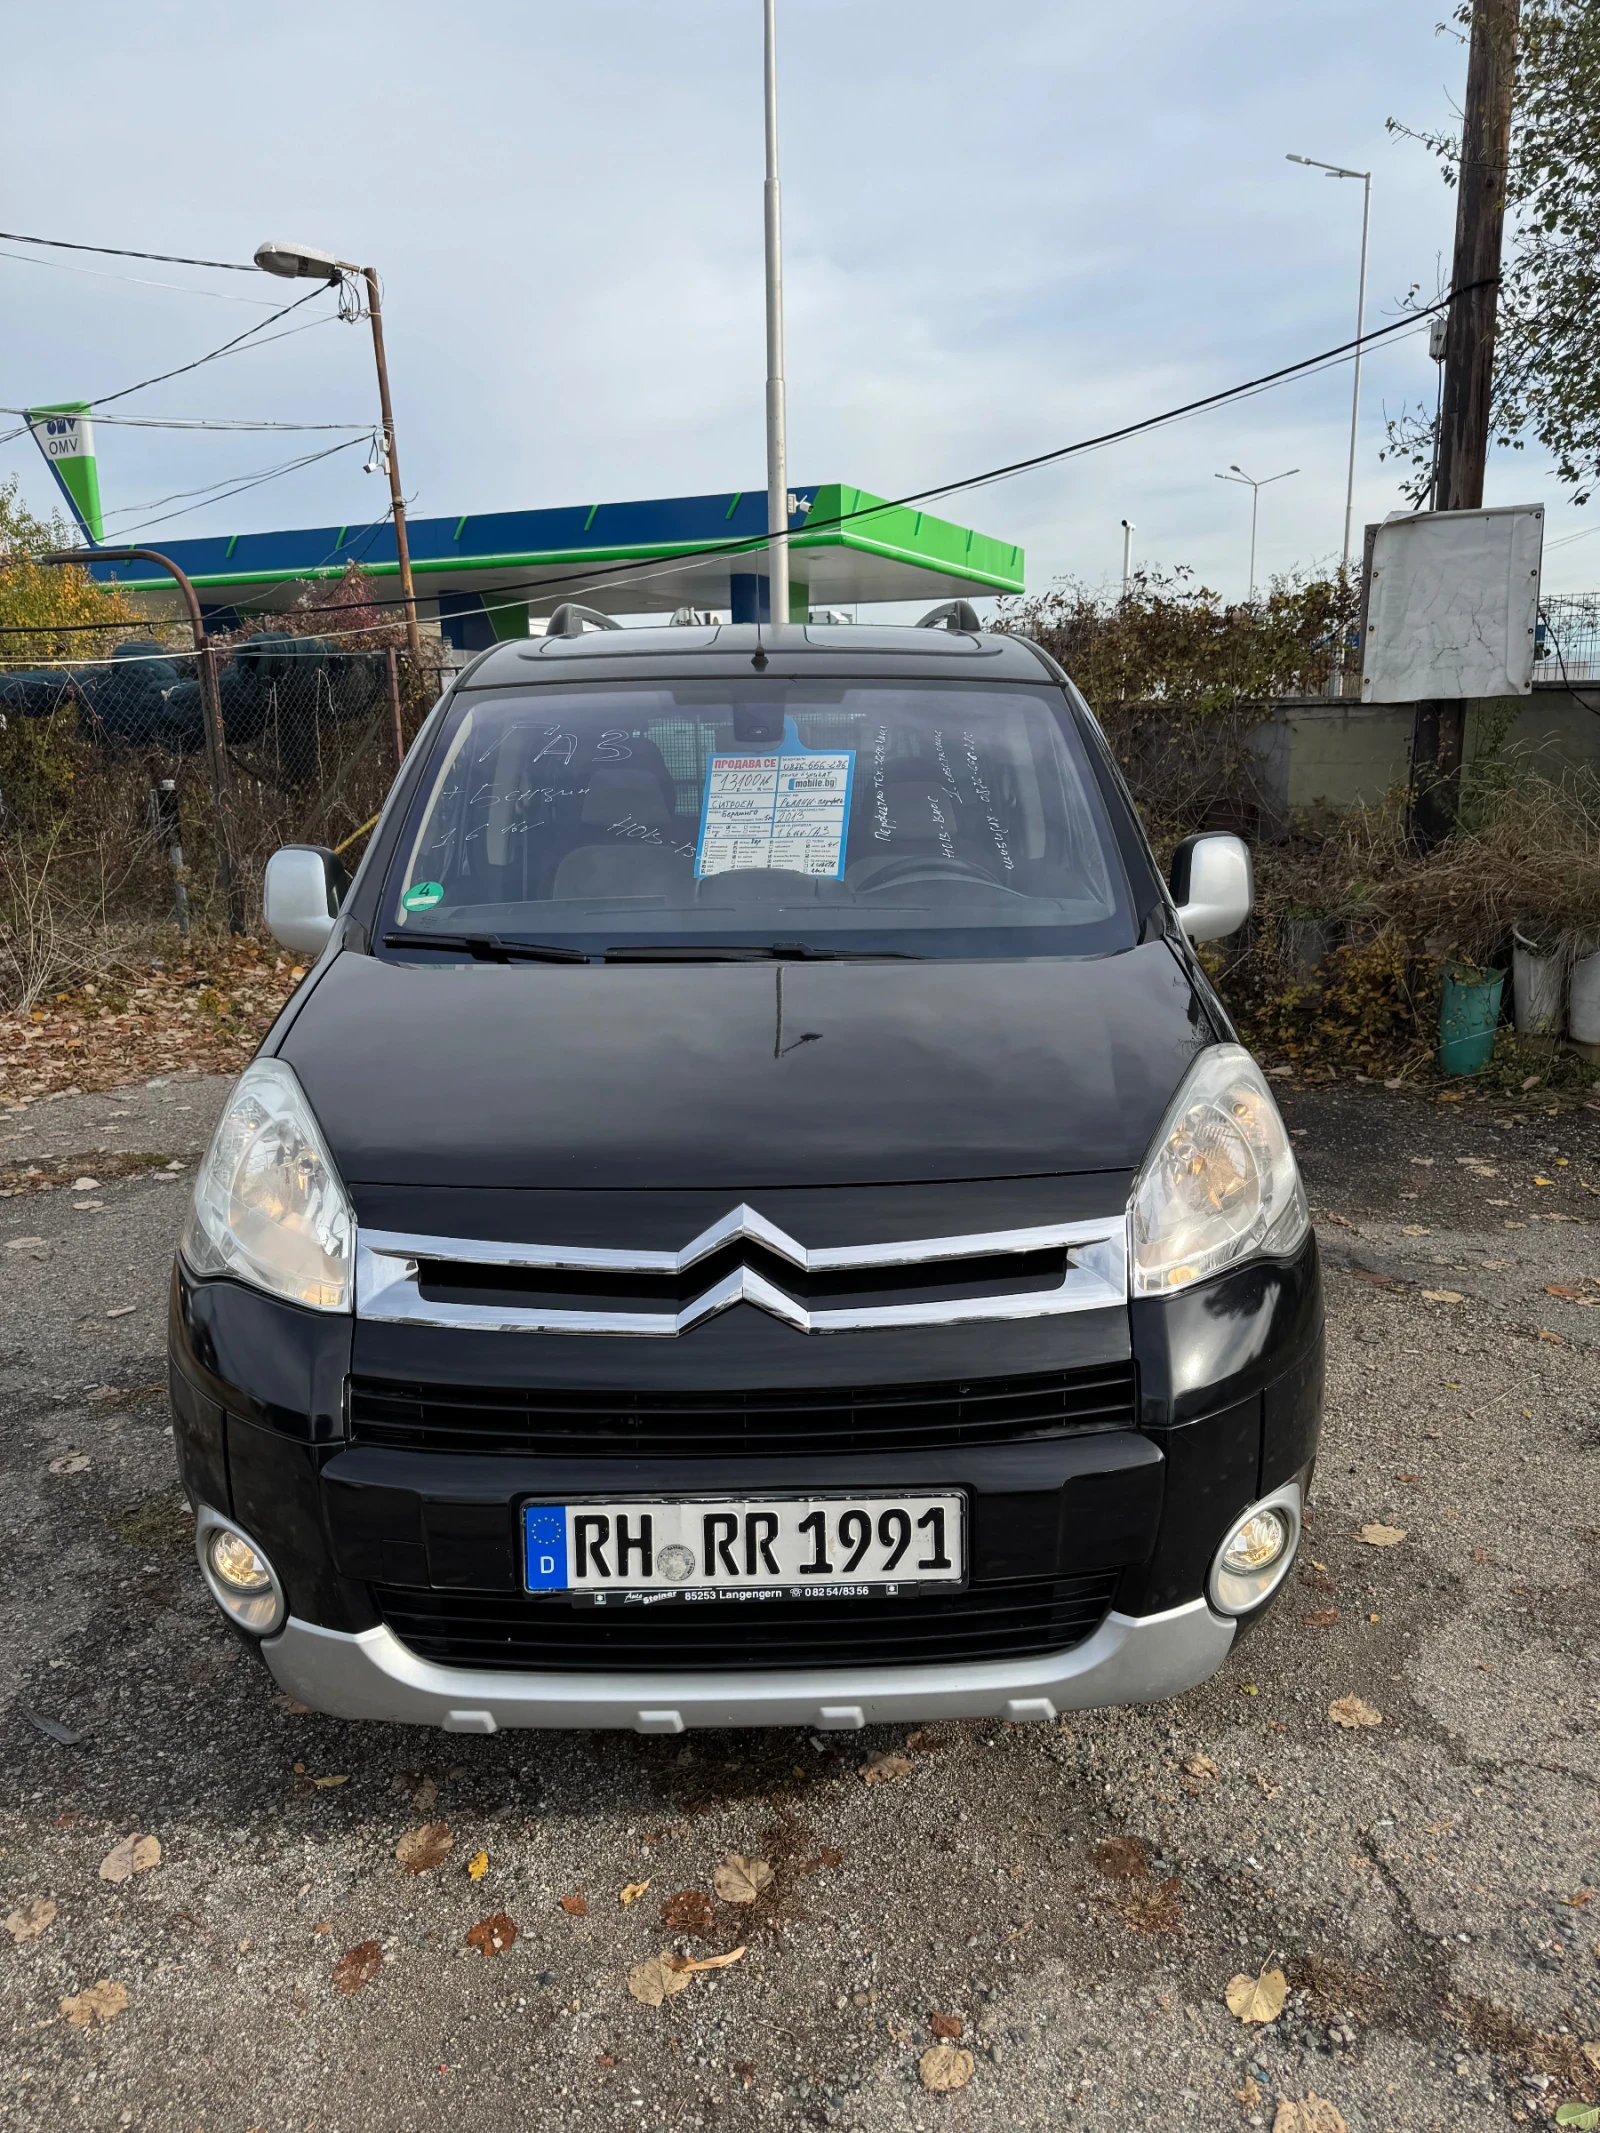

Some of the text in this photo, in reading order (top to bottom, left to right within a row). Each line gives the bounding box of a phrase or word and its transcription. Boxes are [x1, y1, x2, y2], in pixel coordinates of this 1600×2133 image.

[49, 438, 78, 455] OMV
[478, 721, 633, 765] ГАЗ
[714, 759, 776, 769] ПРОДАВА СЕ
[718, 772, 761, 792] 13100
[795, 779, 835, 788] mobile.bg
[418, 883, 430, 896] 4
[574, 1506, 953, 1578] RH RR 1991
[540, 1556, 555, 1574] D
[684, 1590, 716, 1600] 85253
[719, 1590, 782, 1600] Langengern
